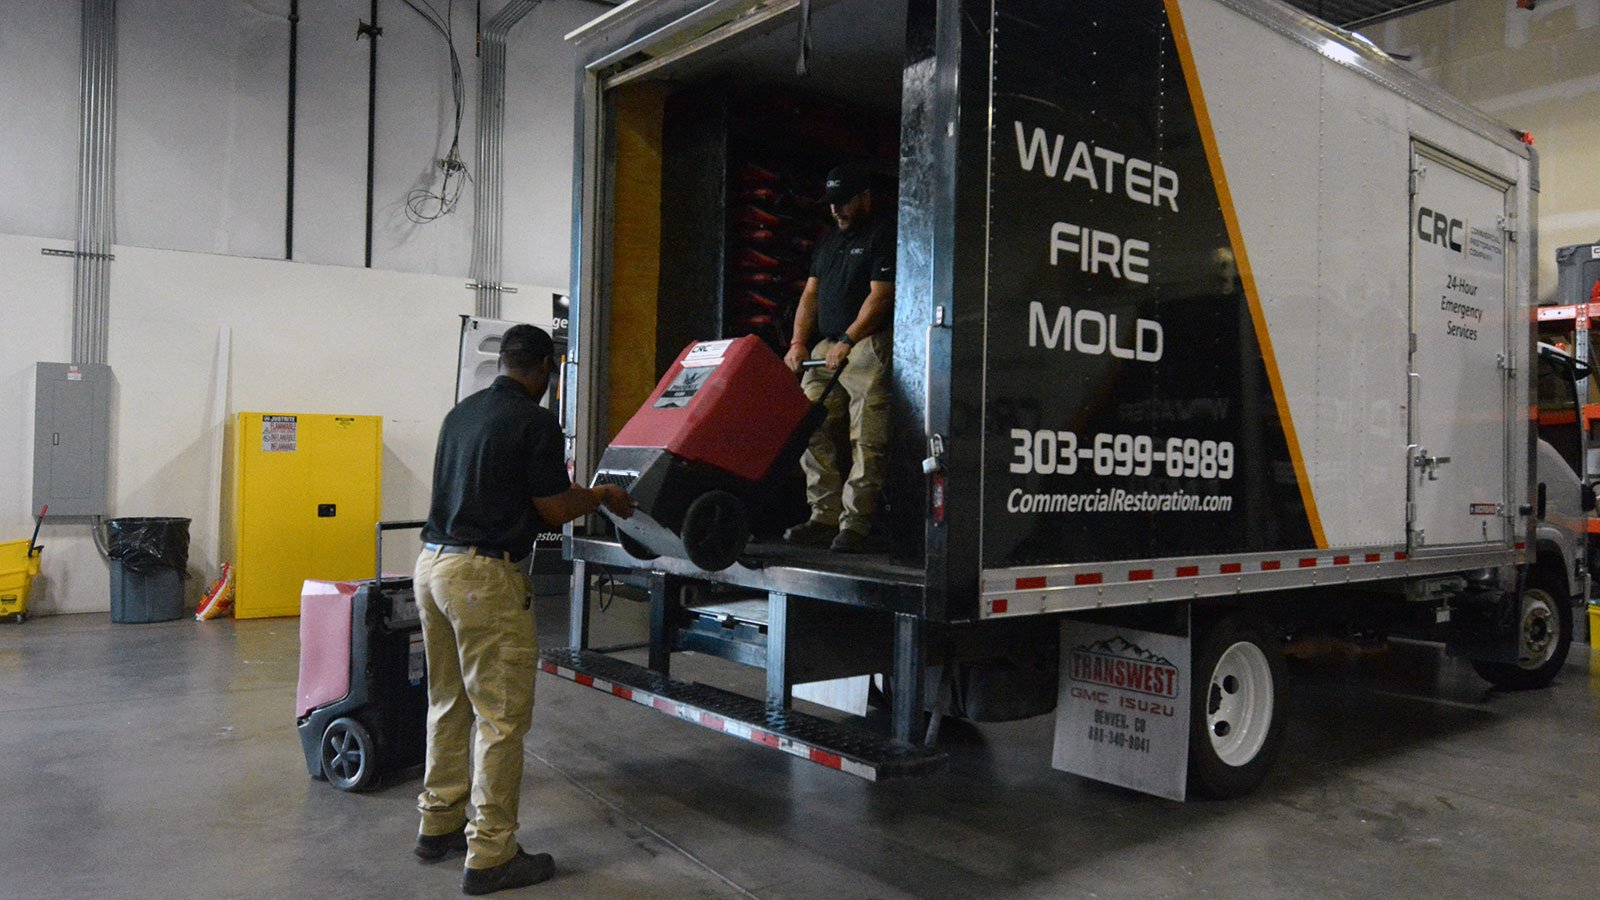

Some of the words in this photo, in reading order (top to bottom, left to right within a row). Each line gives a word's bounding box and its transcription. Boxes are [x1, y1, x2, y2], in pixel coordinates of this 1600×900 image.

[1014, 121, 1179, 213] WATER
[1418, 206, 1463, 253] CRC
[1050, 222, 1150, 284] FIRE
[1446, 274, 1478, 297] 24-Hour
[1441, 295, 1483, 324] Emergency
[1028, 301, 1164, 363] MOLD
[1446, 320, 1478, 341] Services
[1009, 428, 1235, 480] 303-699-6989
[1007, 487, 1233, 514] CommercialRestoration.com
[1073, 652, 1176, 695] TRANSWEST
[1070, 687, 1109, 704] GMC
[1120, 696, 1174, 717] ISUZU
[1135, 717, 1146, 733] CO
